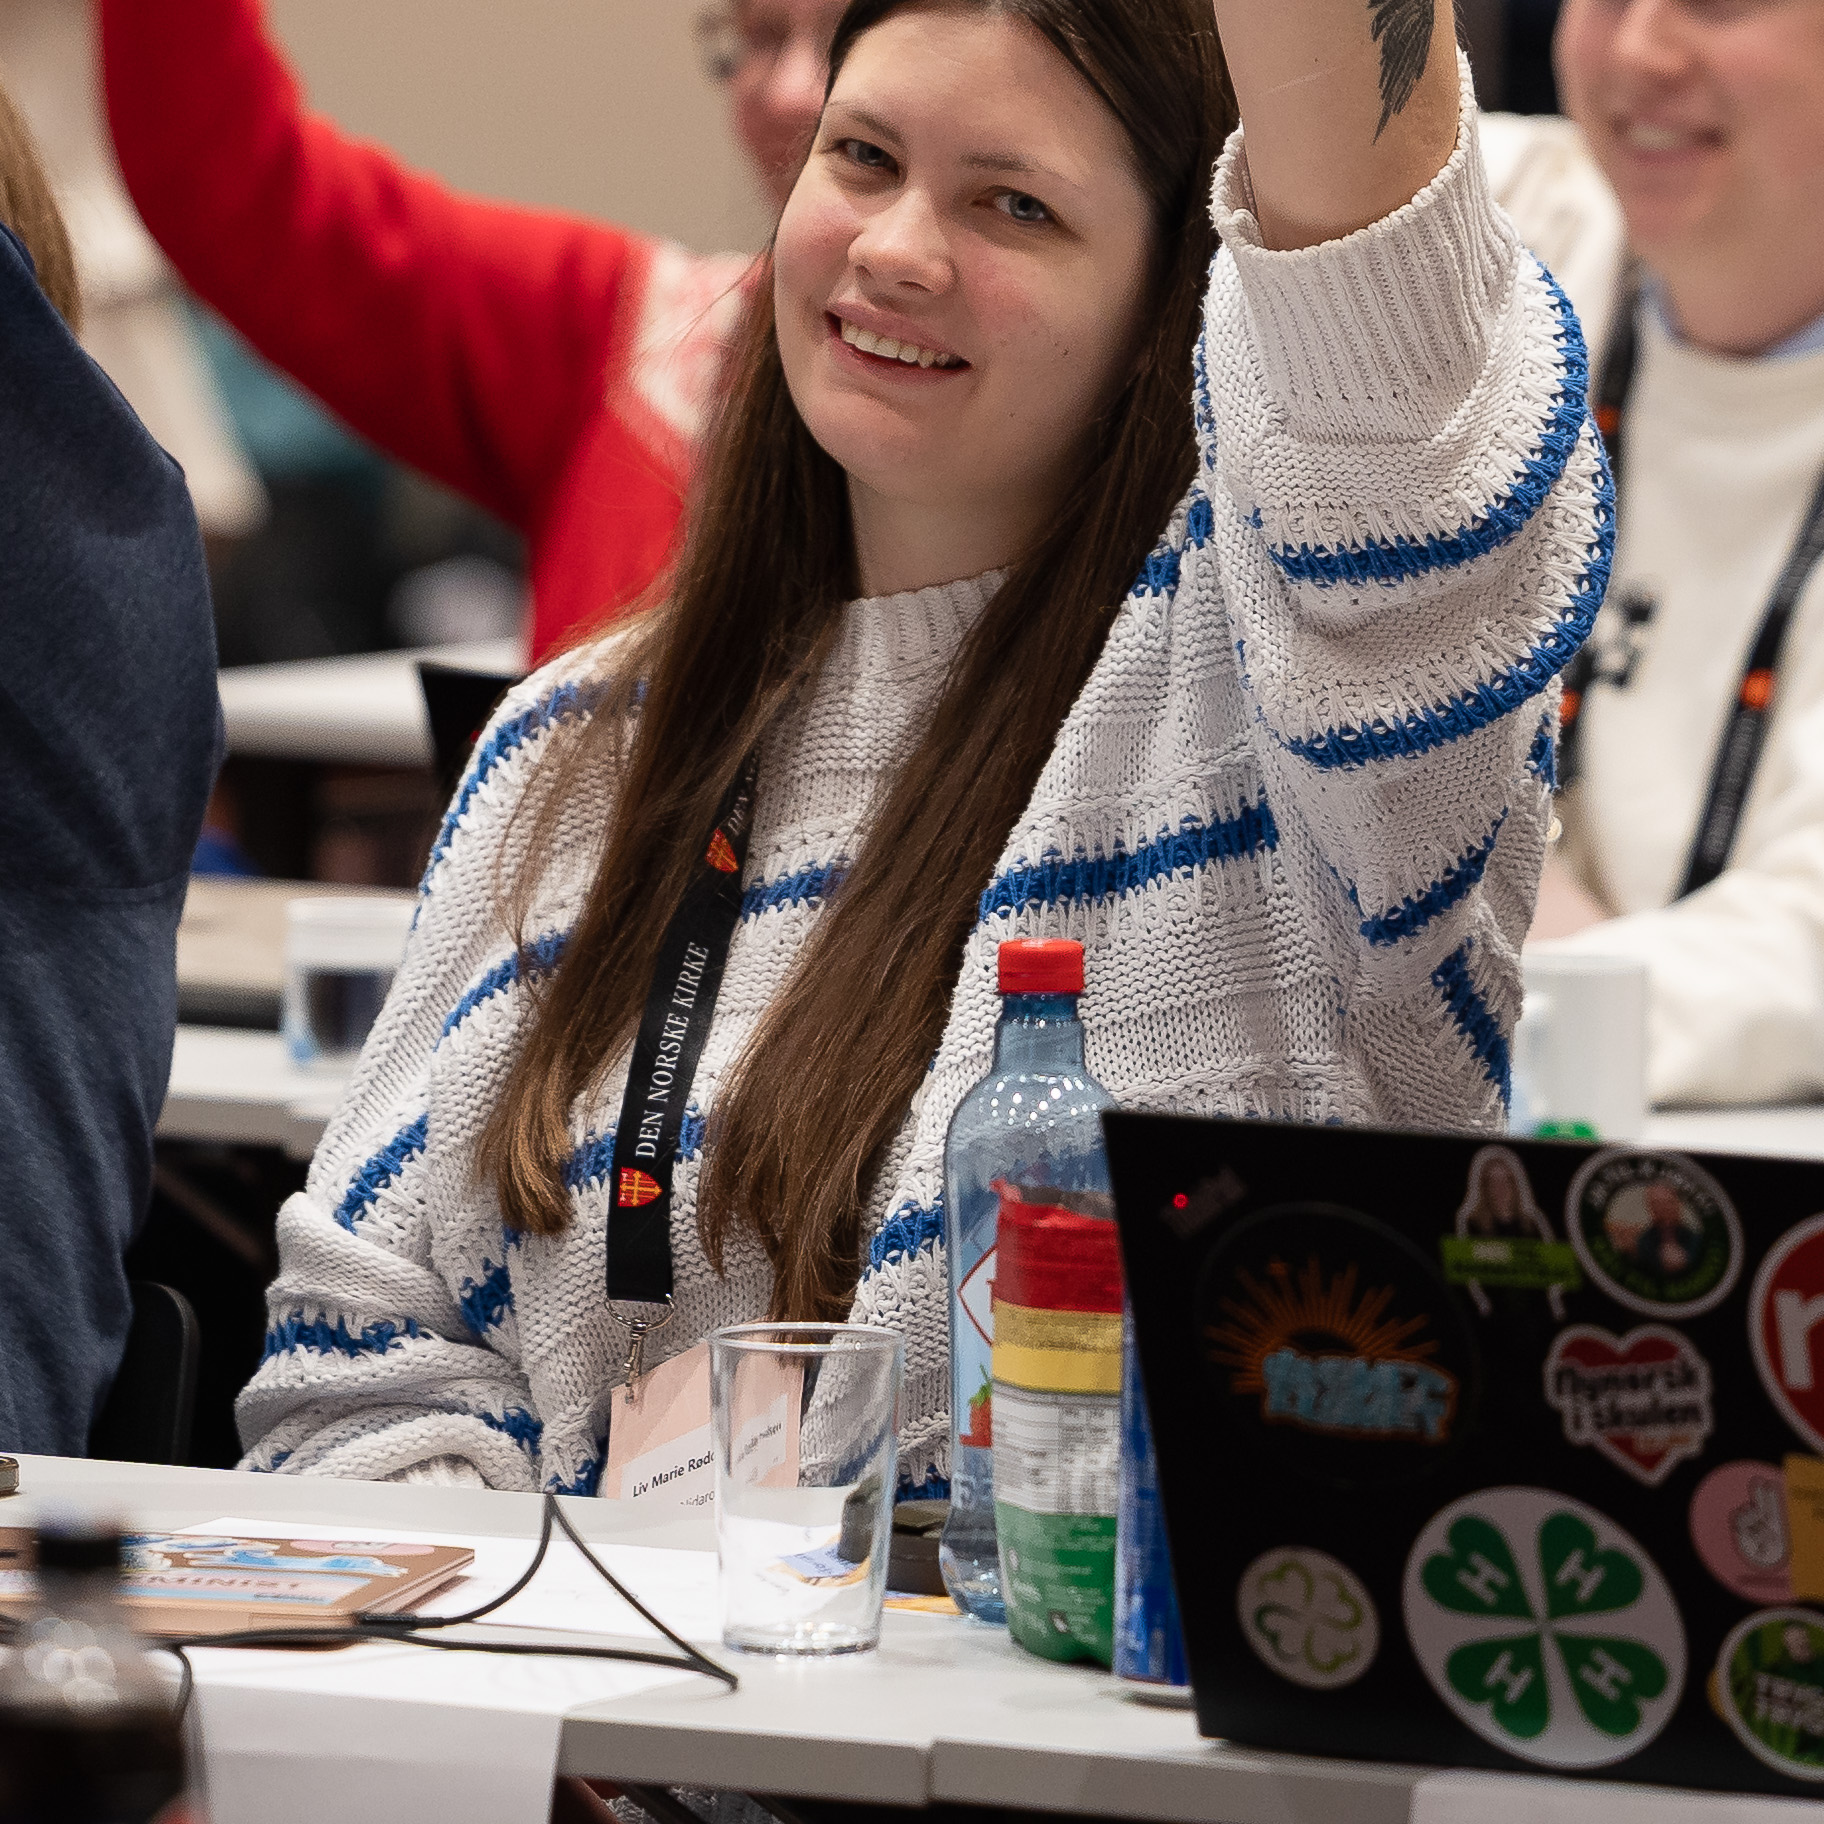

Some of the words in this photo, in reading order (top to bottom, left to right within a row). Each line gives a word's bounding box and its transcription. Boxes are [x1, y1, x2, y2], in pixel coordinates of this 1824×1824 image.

[672, 940, 710, 1009] KIRKE
[647, 1012, 690, 1103] NORSKE
[635, 1109, 666, 1160] DEN
[632, 1481, 648, 1498] Liv
[651, 1465, 685, 1490] Marie
